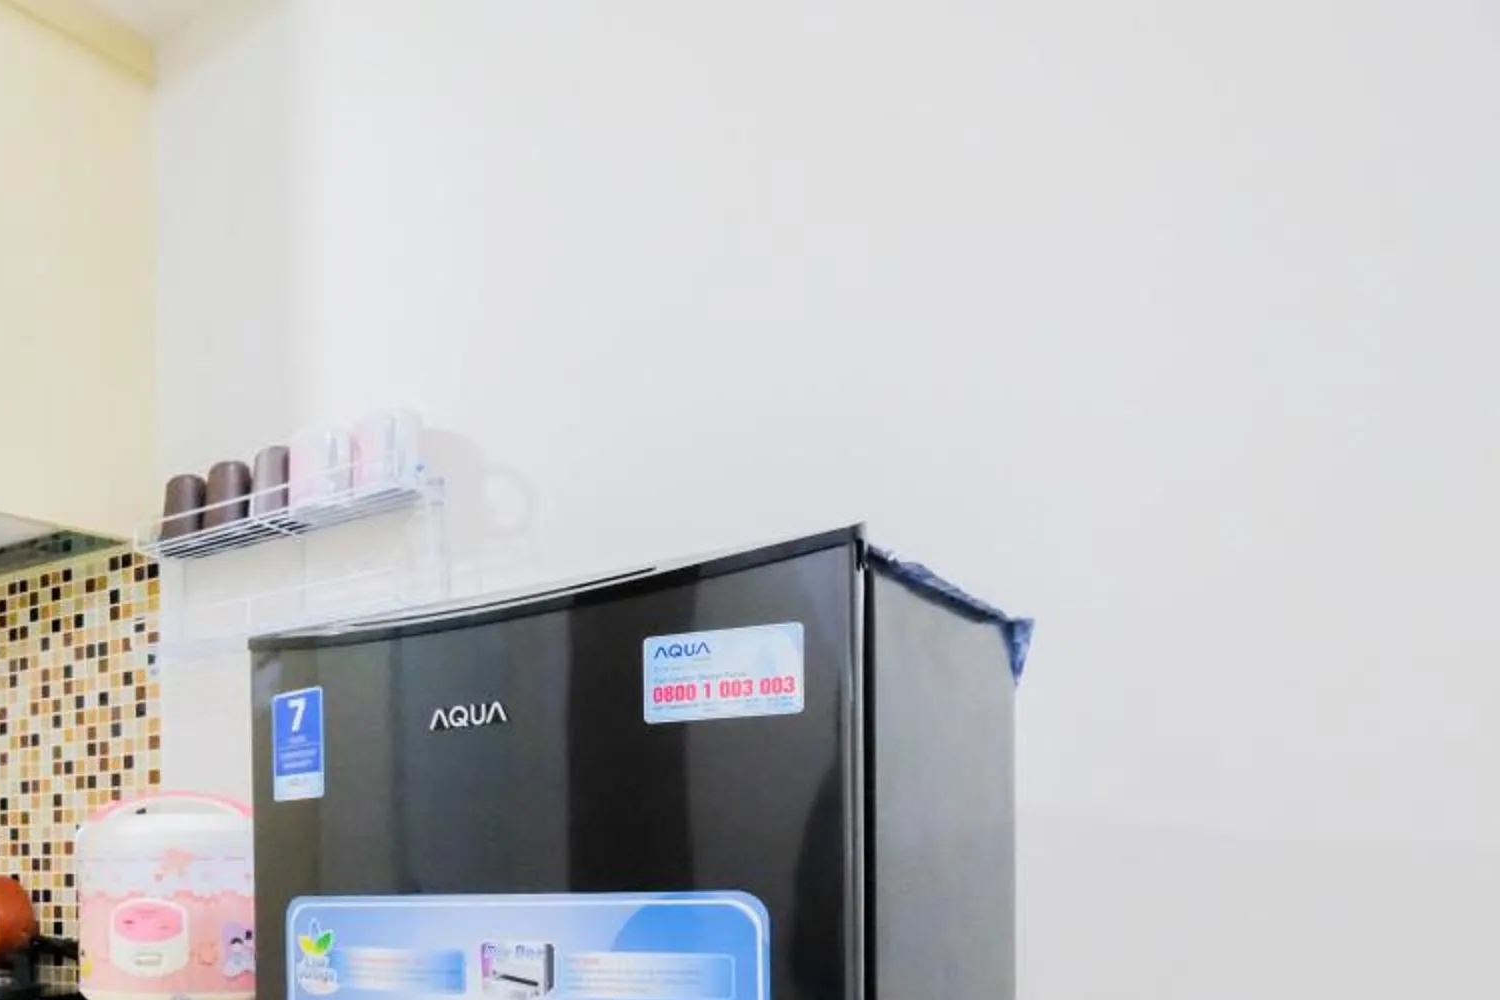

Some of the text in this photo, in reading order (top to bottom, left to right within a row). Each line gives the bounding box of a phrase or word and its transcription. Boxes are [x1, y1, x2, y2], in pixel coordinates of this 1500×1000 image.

[654, 641, 711, 660] AQUA
[653, 683, 697, 704] 0800
[703, 681, 711, 698] 1
[719, 679, 754, 698] 003
[759, 676, 796, 694] 003
[287, 698, 307, 732] 7
[429, 701, 508, 731] AQUA
